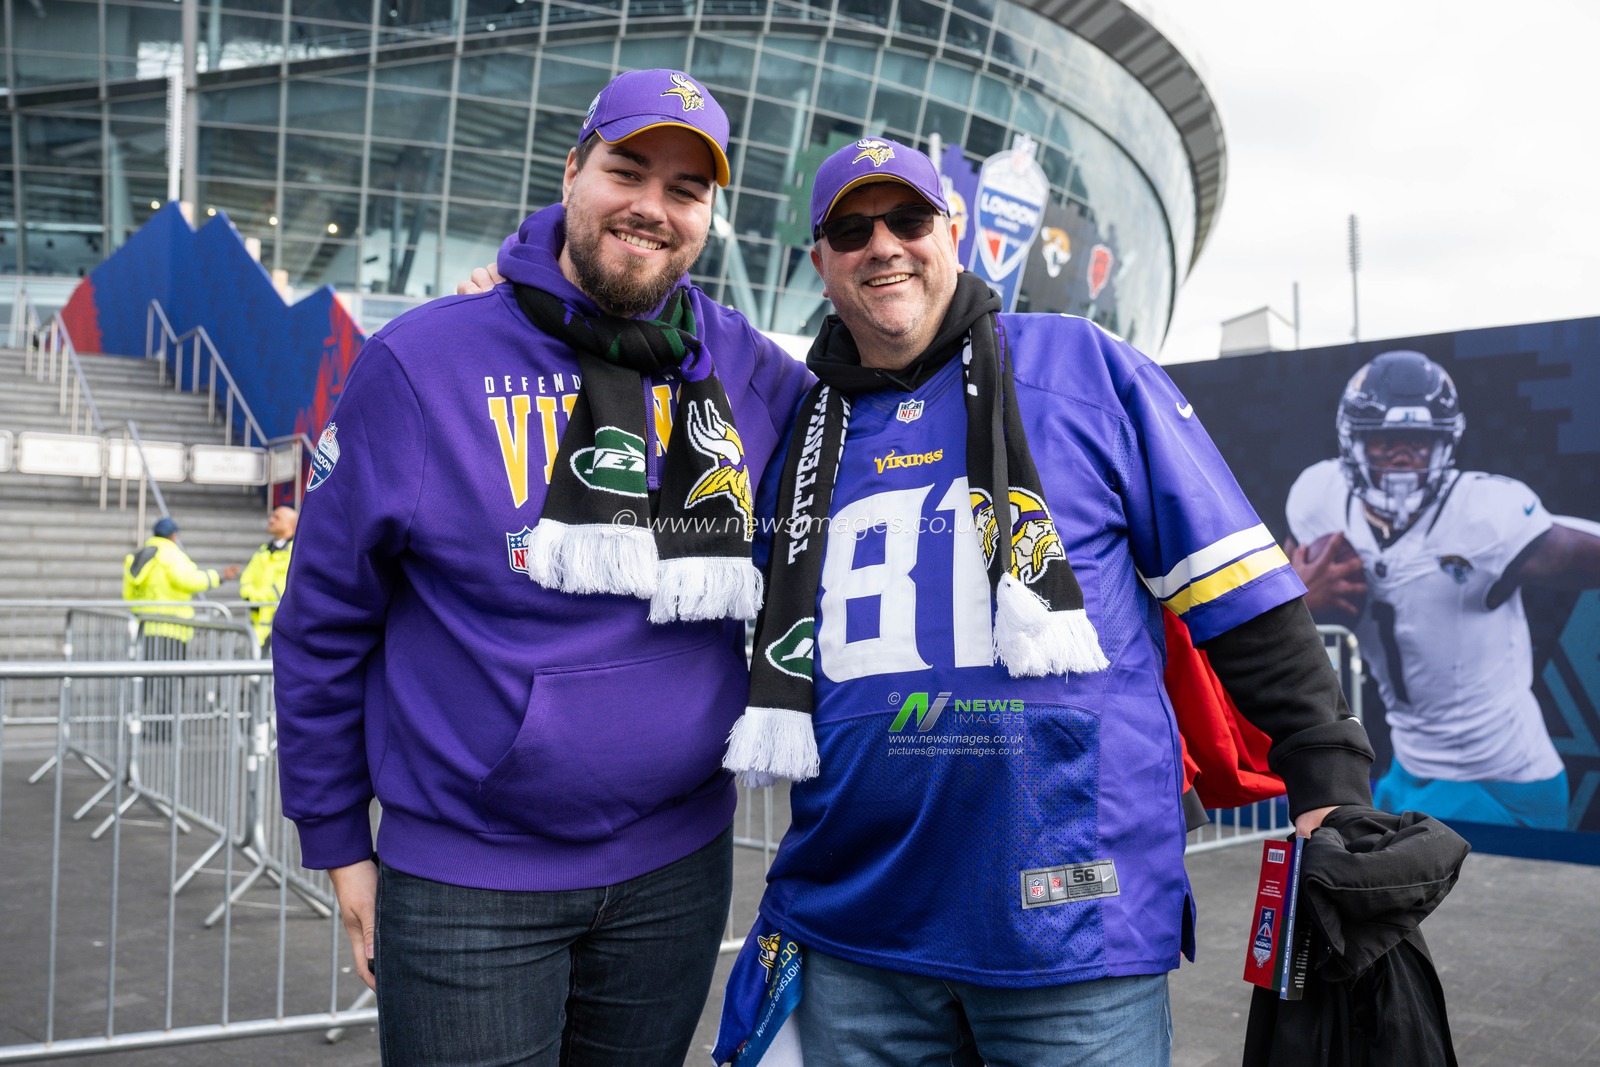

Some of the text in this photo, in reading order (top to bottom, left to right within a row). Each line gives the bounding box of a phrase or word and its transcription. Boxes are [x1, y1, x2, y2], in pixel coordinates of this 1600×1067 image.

[980, 192, 1040, 228] LONDON
[484, 373, 581, 393] DEFEND
[901, 409, 918, 418] NFL
[817, 476, 996, 684] 81
[1072, 868, 1096, 883] 56
[1031, 886, 1044, 896] NFL
[780, 941, 799, 969] OCT
[774, 962, 801, 1002] HOTSPUR
